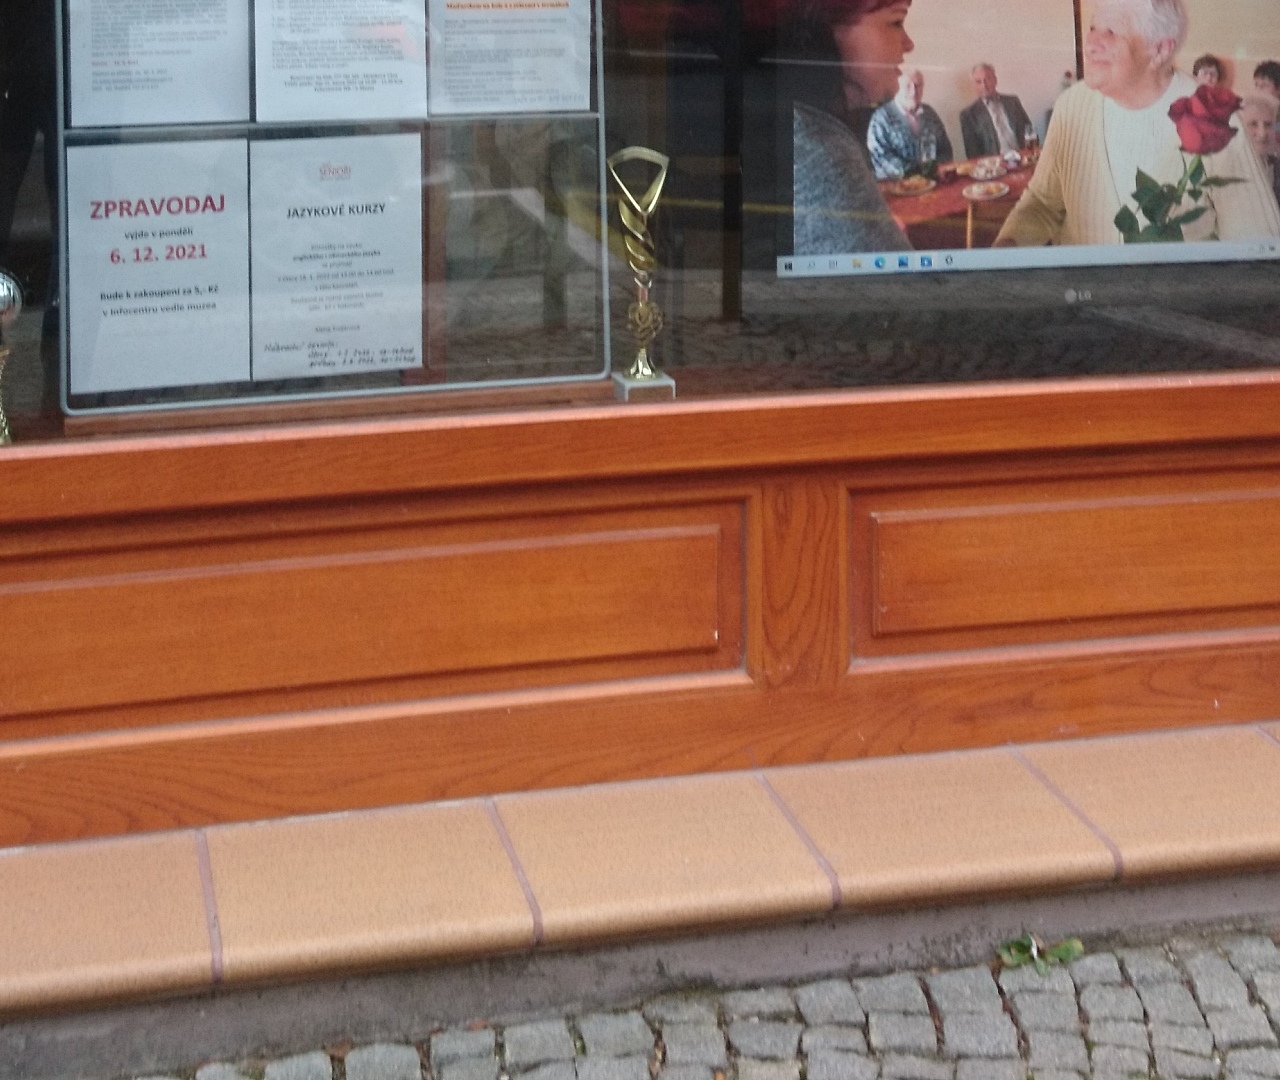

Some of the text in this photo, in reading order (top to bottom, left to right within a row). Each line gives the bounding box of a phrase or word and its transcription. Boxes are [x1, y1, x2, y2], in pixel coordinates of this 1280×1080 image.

[90, 194, 225, 219] ZPRAVODAJ
[286, 202, 386, 219] JAZYKOVÉ KURZY
[110, 243, 207, 264] 6. 12. 2021
